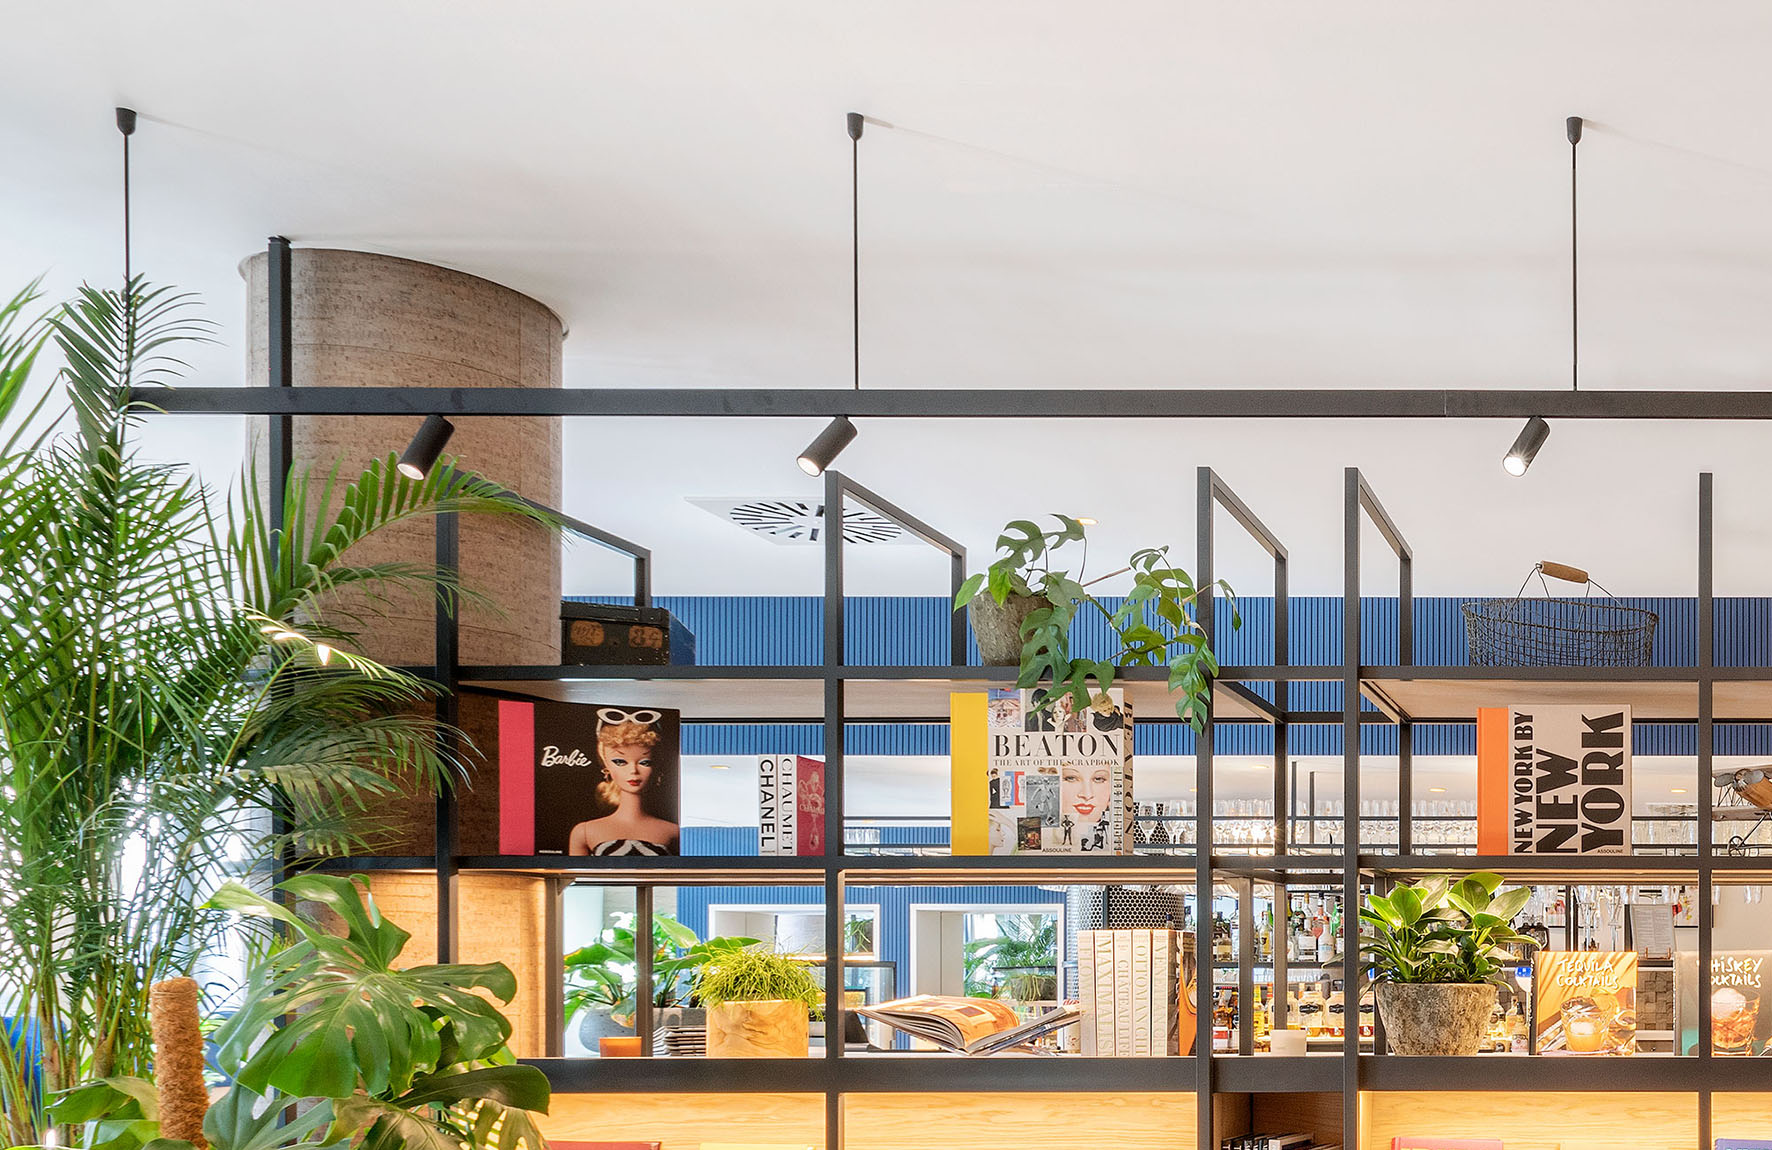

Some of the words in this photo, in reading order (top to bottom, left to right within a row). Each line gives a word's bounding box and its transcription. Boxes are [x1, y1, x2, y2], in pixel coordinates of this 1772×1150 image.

[1514, 711, 1533, 741] BY
[540, 745, 592, 768] Barbie
[993, 734, 1120, 758] BEATON
[993, 759, 1012, 767] THE
[1015, 759, 1031, 767] ART
[1033, 759, 1044, 767] OF
[1066, 759, 1120, 767] SCRAPBOOK
[1514, 745, 1533, 805] YORK
[1581, 711, 1625, 853] YORK
[760, 759, 775, 848] CHANEL
[782, 758, 793, 855] CHAUMET
[1536, 748, 1578, 853] NEW
[1514, 808, 1533, 853] NEW
[1710, 956, 1763, 974] HISKEY
[1711, 972, 1762, 988] OCKTAILS
[1135, 1027, 1148, 1055] CHI
